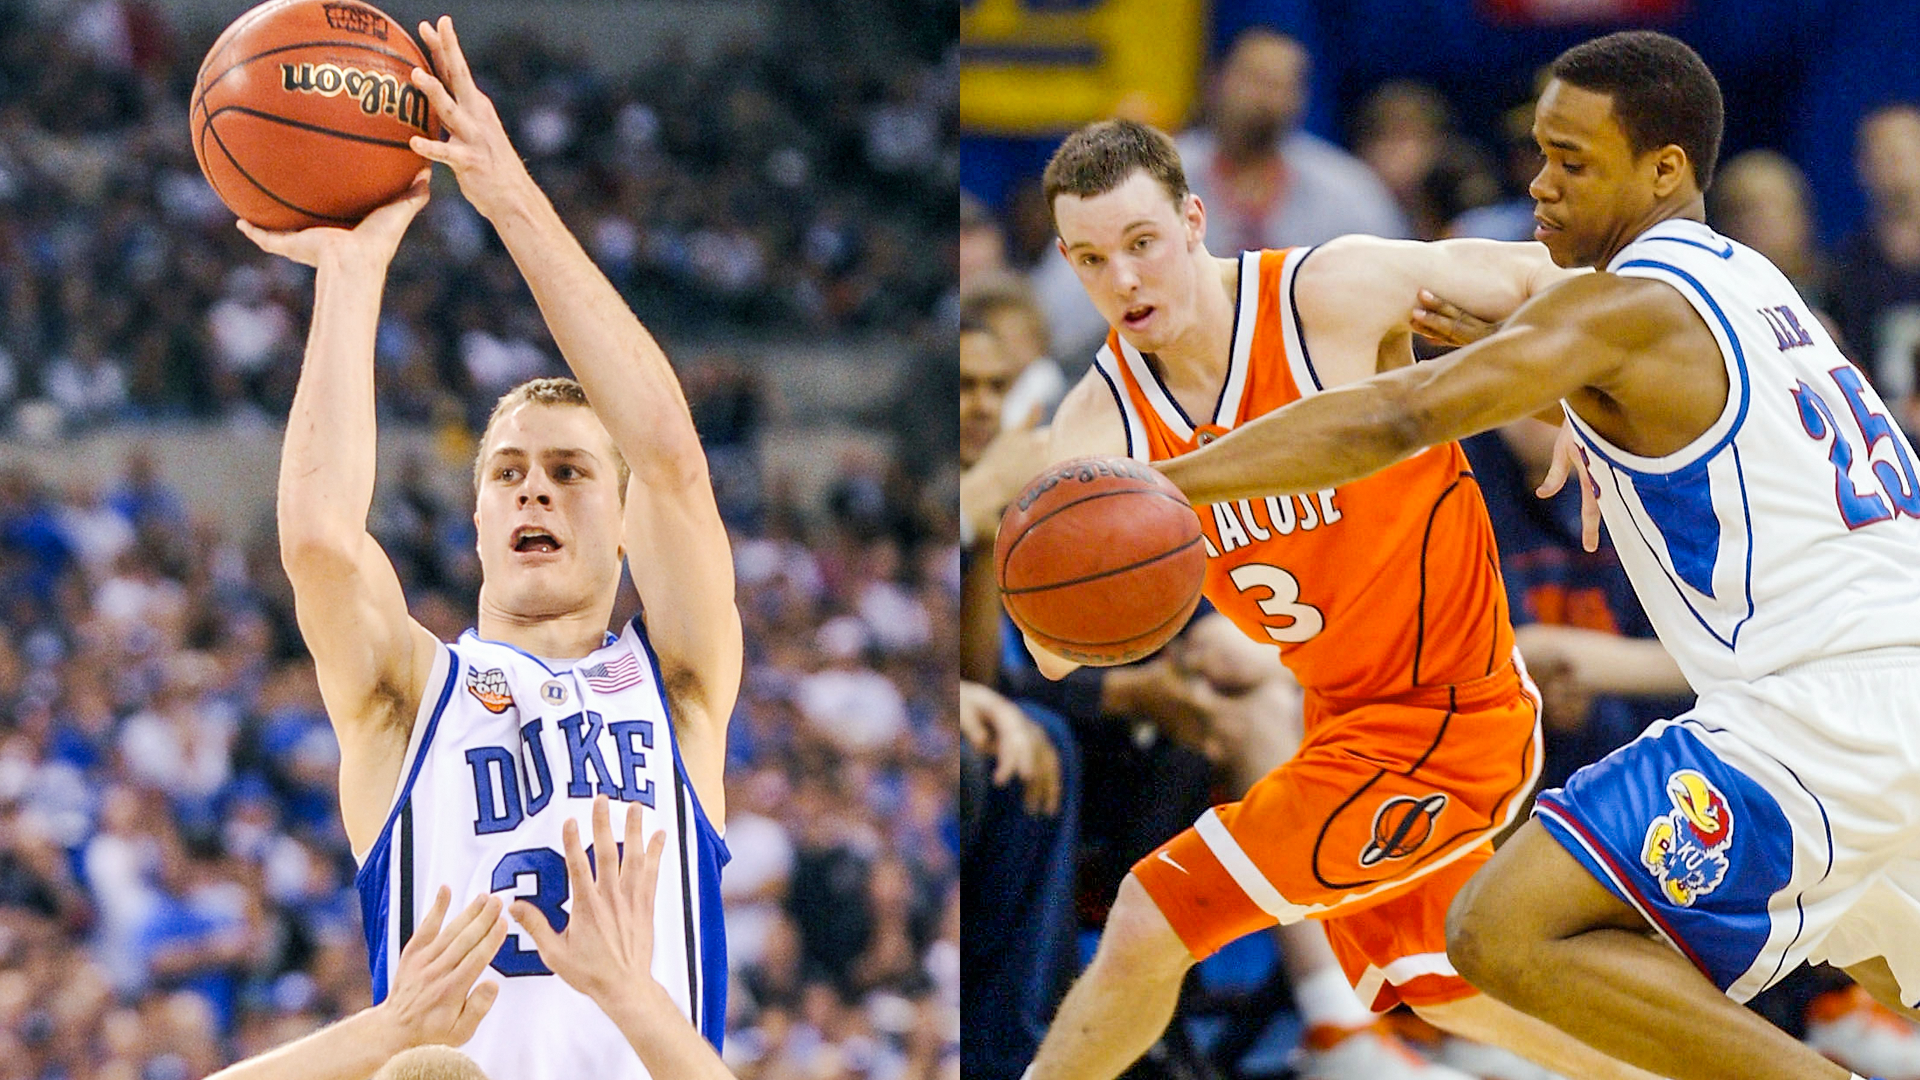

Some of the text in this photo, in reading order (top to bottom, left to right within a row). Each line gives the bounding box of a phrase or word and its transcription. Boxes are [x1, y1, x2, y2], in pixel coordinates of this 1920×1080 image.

[279, 62, 429, 134] Wilson
[1788, 365, 1920, 530] 25
[1201, 487, 1344, 558] ACUSE
[1228, 562, 1326, 644] 3
[464, 709, 656, 836] DUKE
[1677, 840, 1704, 871] KU
[489, 841, 625, 978] 3
